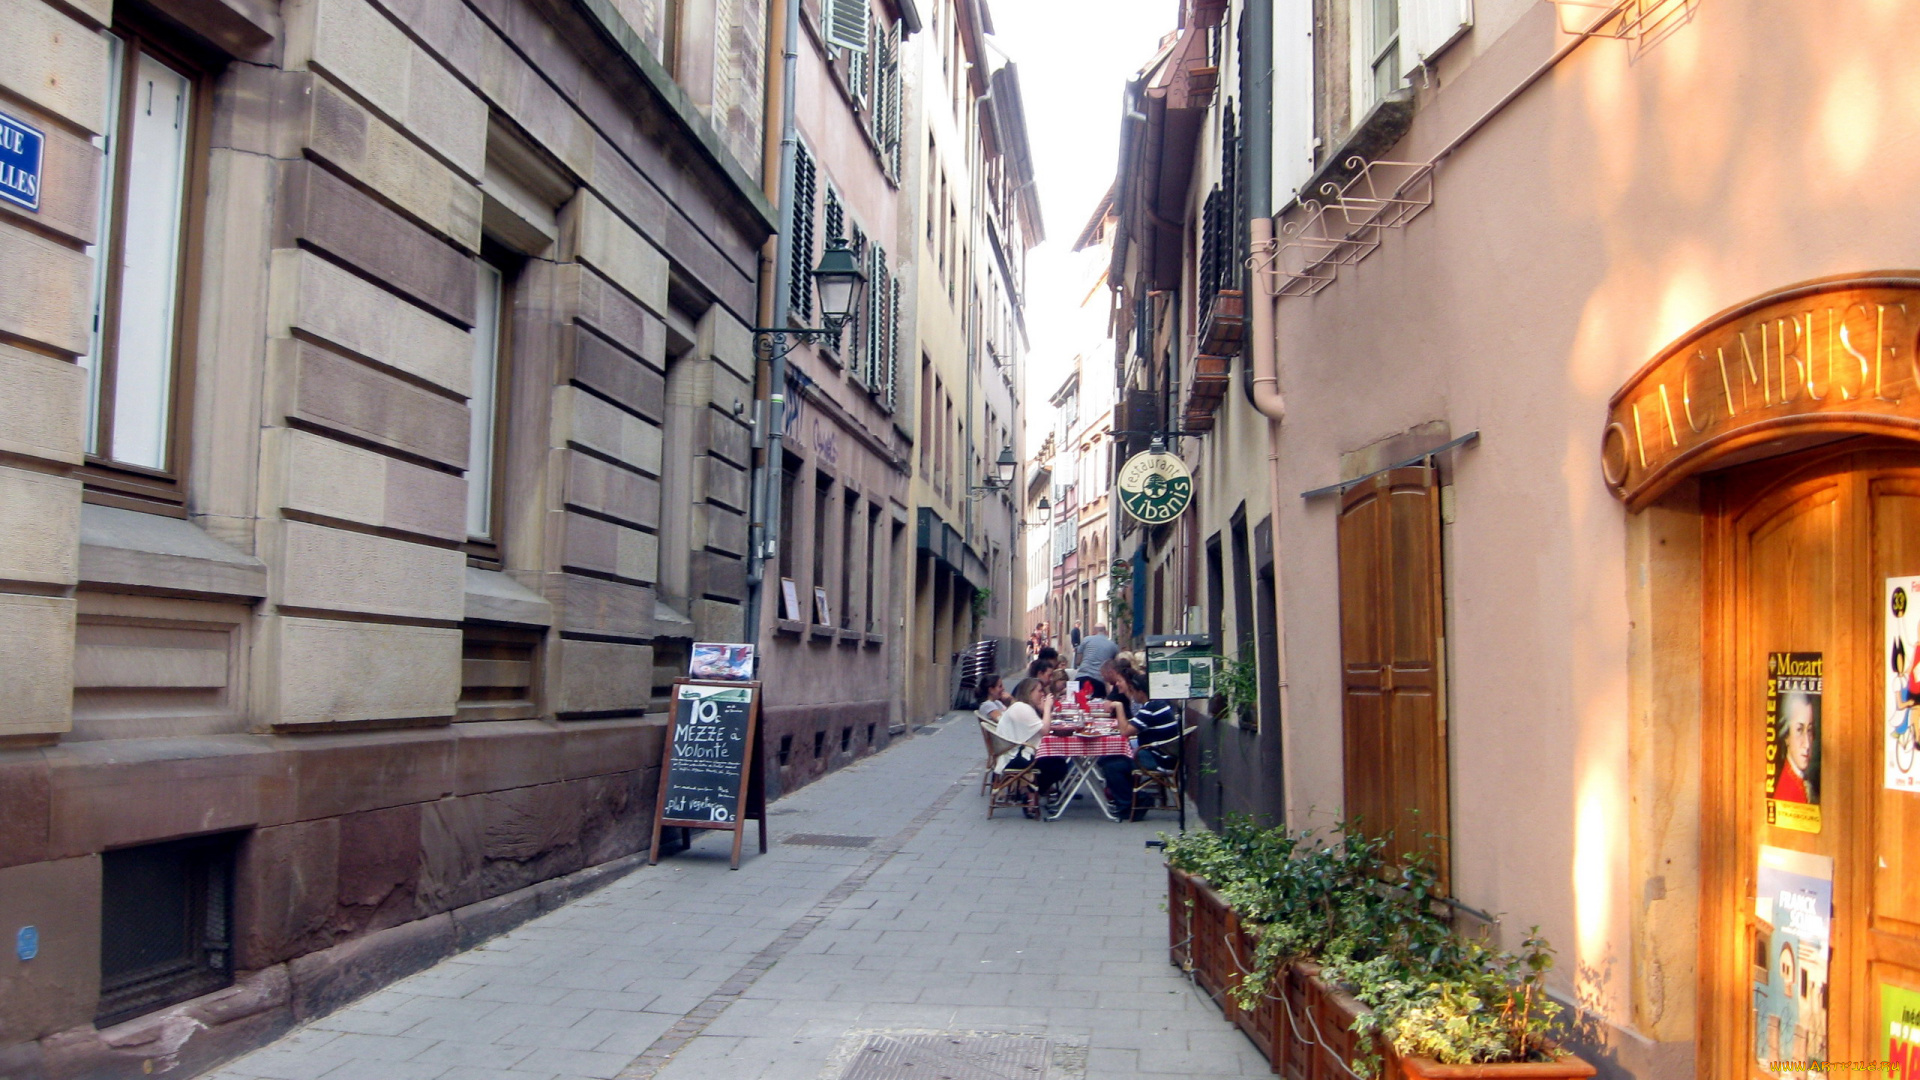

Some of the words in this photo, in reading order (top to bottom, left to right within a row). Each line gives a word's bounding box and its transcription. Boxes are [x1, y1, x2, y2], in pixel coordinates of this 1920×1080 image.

[1127, 458, 1180, 488] restaurant
[1126, 482, 1189, 519] Libanis
[1777, 653, 1822, 676] Mozart
[1777, 680, 1822, 691] PRAGUE
[1766, 679, 1777, 793] REQUIEM
